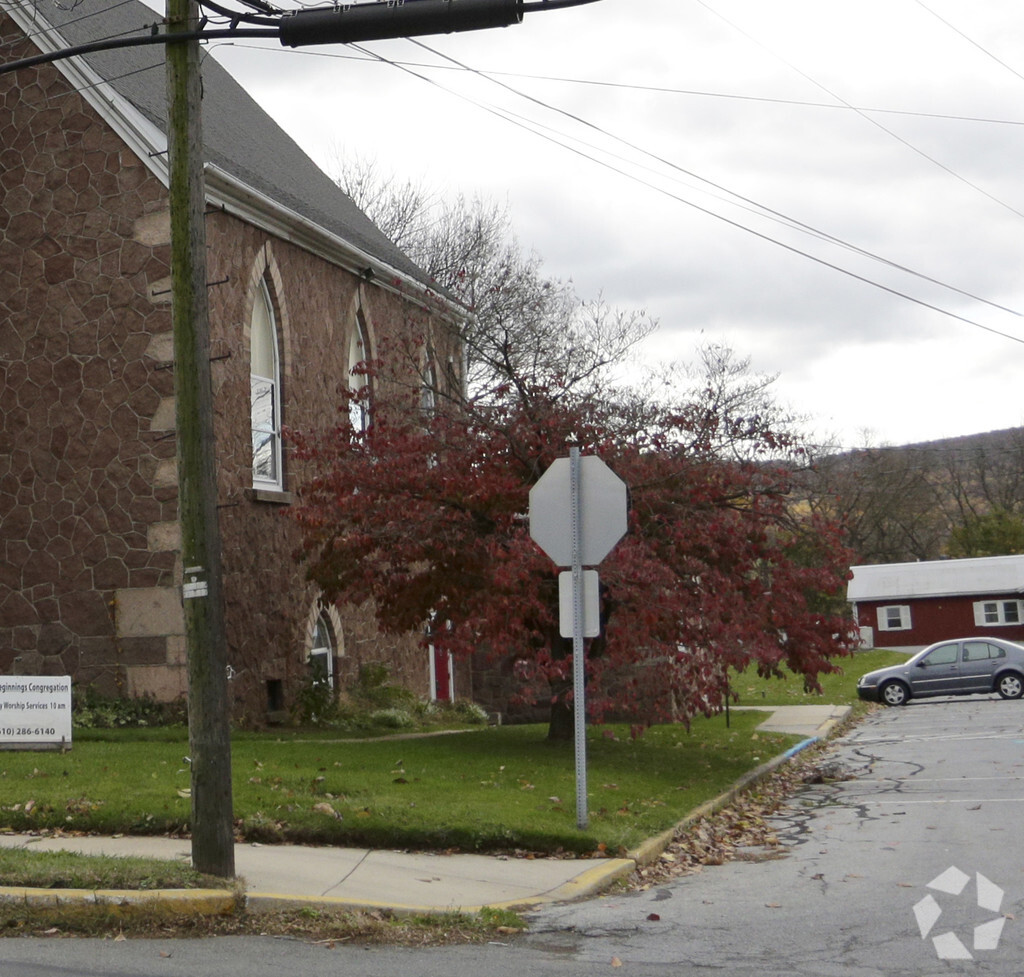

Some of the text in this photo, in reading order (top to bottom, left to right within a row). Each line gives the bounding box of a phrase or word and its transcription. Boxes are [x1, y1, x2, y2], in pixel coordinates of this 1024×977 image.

[28, 682, 69, 693] Congregation
[3, 702, 26, 711] Worship
[26, 701, 48, 710] Services
[16, 727, 56, 735] 286-6140
